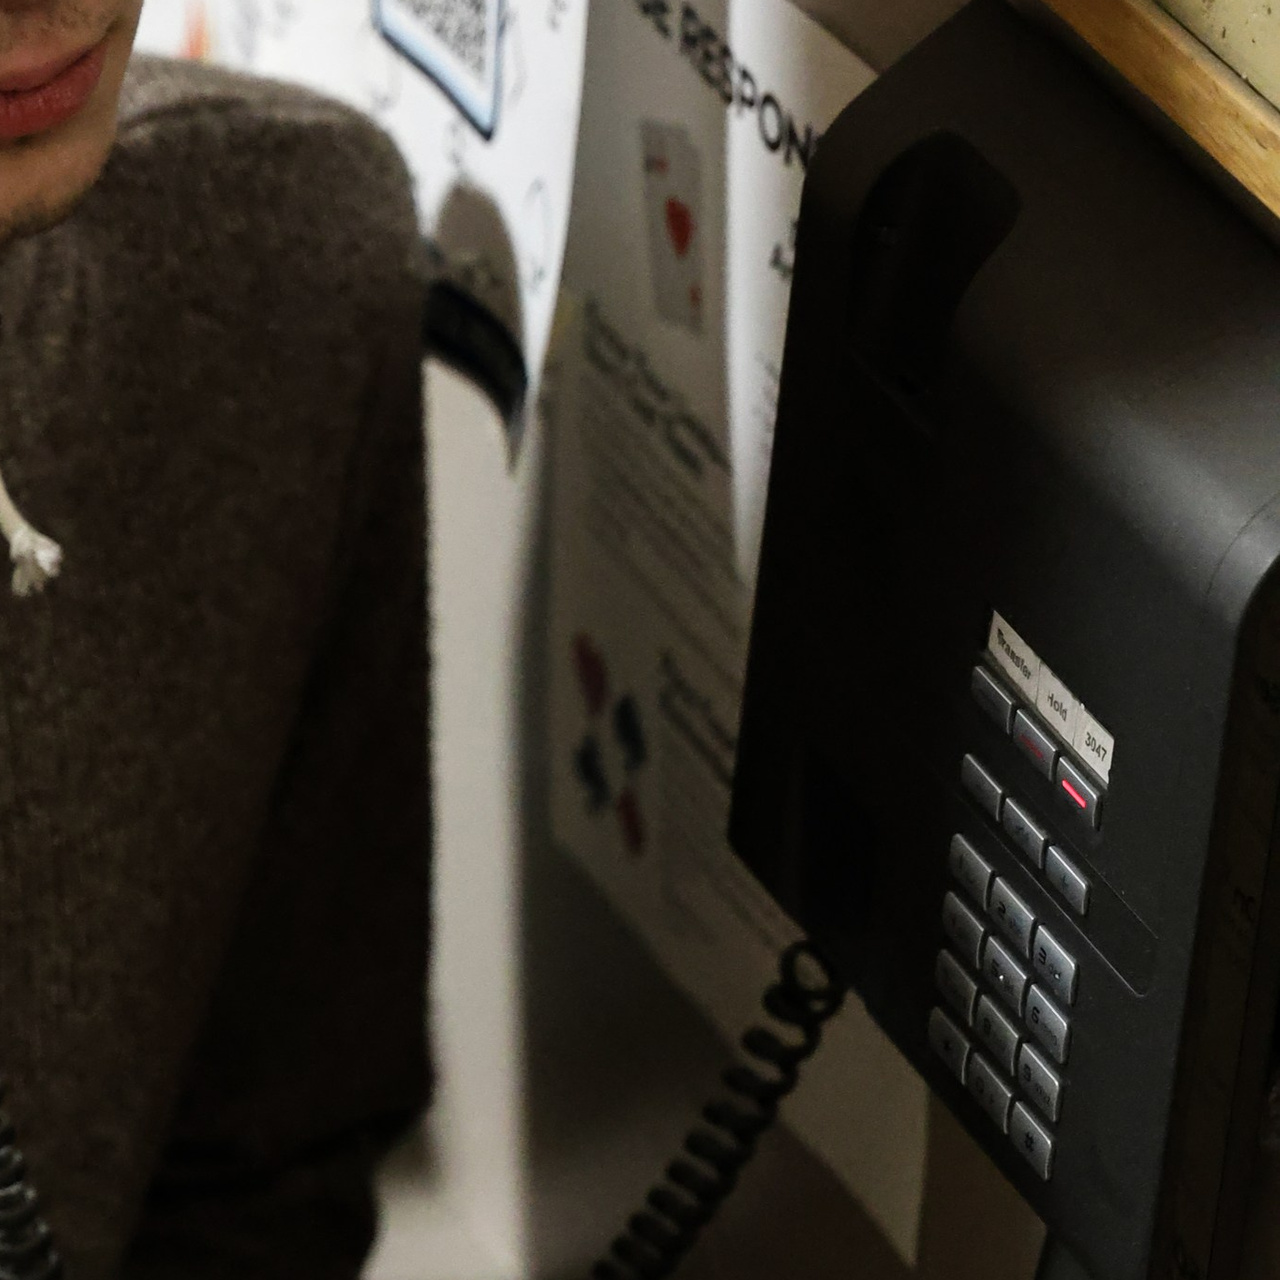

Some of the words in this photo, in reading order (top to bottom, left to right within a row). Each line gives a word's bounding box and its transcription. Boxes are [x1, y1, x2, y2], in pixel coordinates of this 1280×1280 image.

[996, 627, 1032, 680] Transfer
[1047, 691, 1067, 722] Hold
[1084, 731, 1108, 762] 3047
[1038, 946, 1048, 966] 3
[1031, 1006, 1040, 1025] 6
